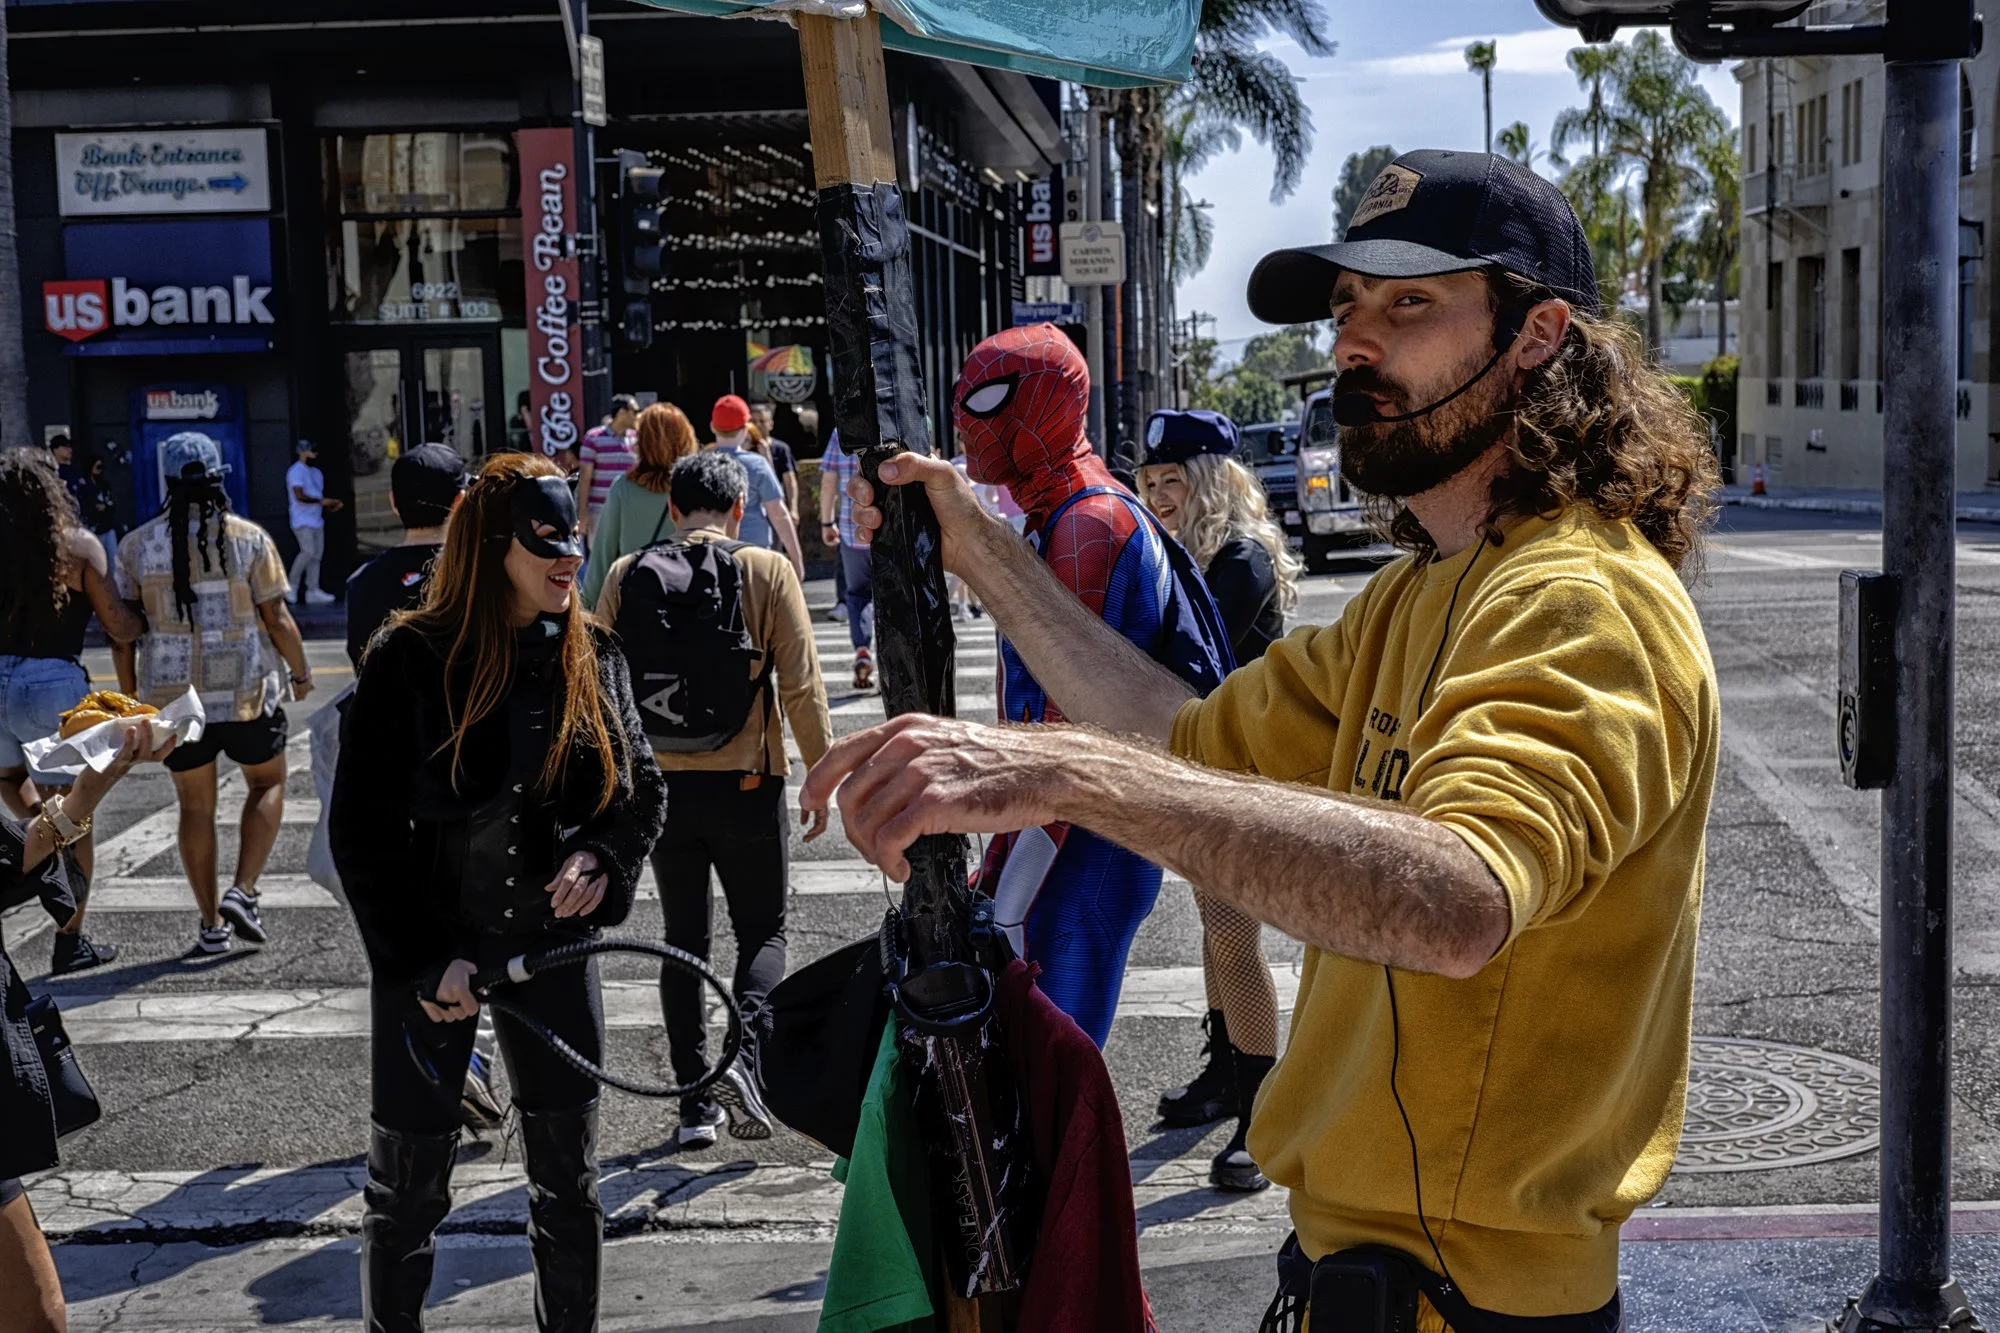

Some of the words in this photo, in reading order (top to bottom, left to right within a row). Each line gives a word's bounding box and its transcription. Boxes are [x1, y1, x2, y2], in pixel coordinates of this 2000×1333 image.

[81, 143, 144, 167] Bank
[150, 143, 242, 166] Entrance
[533, 162, 568, 271] Bean
[1069, 256, 1116, 266] MIRANDA
[1072, 247, 1111, 256] CARMEN
[412, 282, 458, 299] 6922
[379, 303, 430, 321] SUITE
[460, 301, 489, 317] 103
[536, 274, 571, 385] Coffee
[541, 390, 578, 457] The
